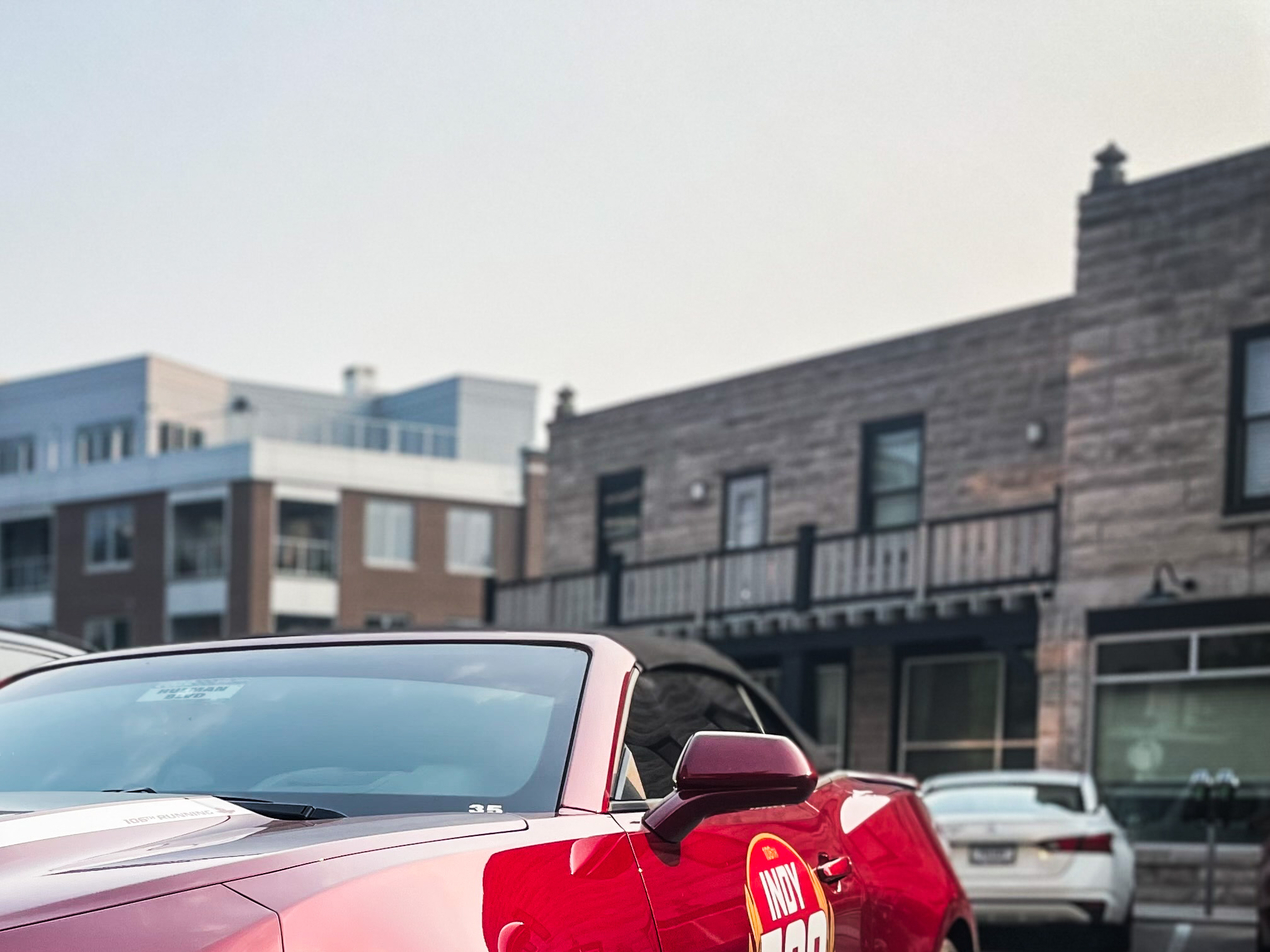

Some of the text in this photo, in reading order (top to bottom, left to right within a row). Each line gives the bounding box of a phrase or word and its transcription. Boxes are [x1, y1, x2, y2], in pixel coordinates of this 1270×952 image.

[157, 809, 215, 821] RUNNING
[468, 804, 504, 814] 35
[759, 861, 806, 921] INDY
